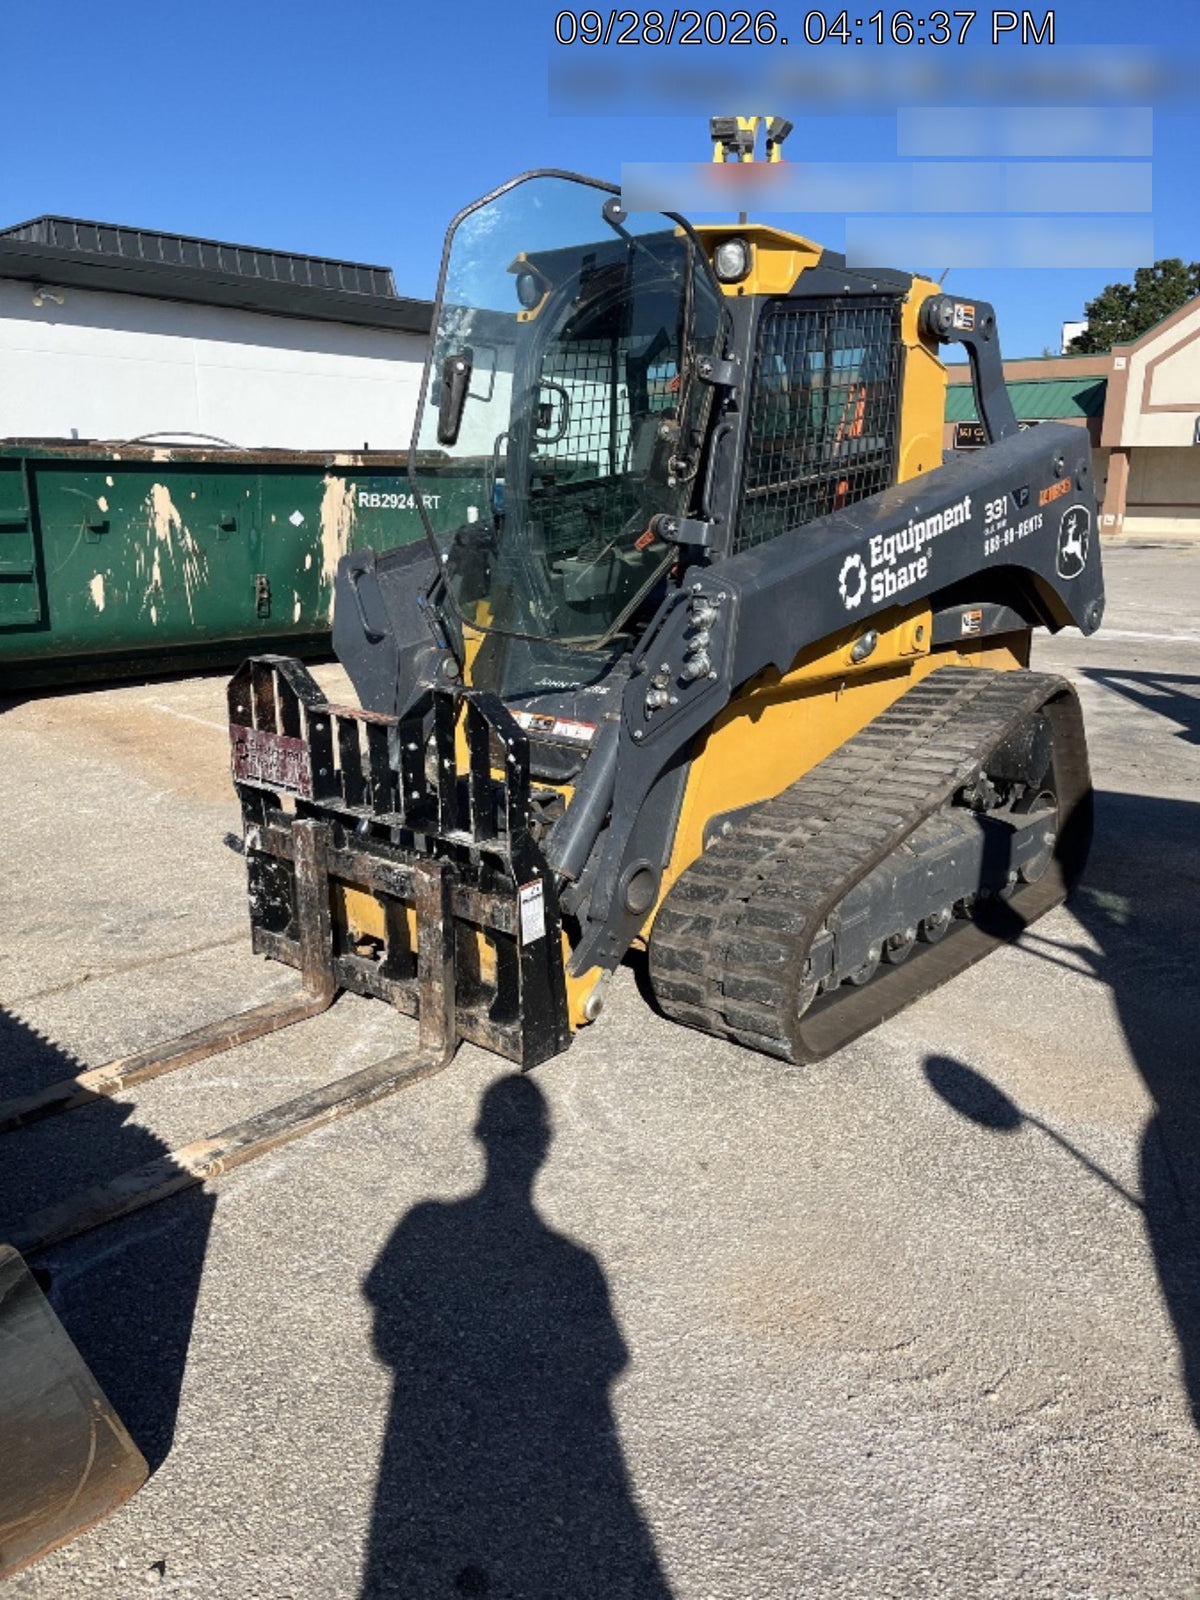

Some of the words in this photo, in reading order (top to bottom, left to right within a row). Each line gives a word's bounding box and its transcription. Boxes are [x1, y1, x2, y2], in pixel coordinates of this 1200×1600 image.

[358, 492, 441, 509] RB2924RT
[984, 495, 1008, 524] 331
[869, 495, 972, 566] Equipment
